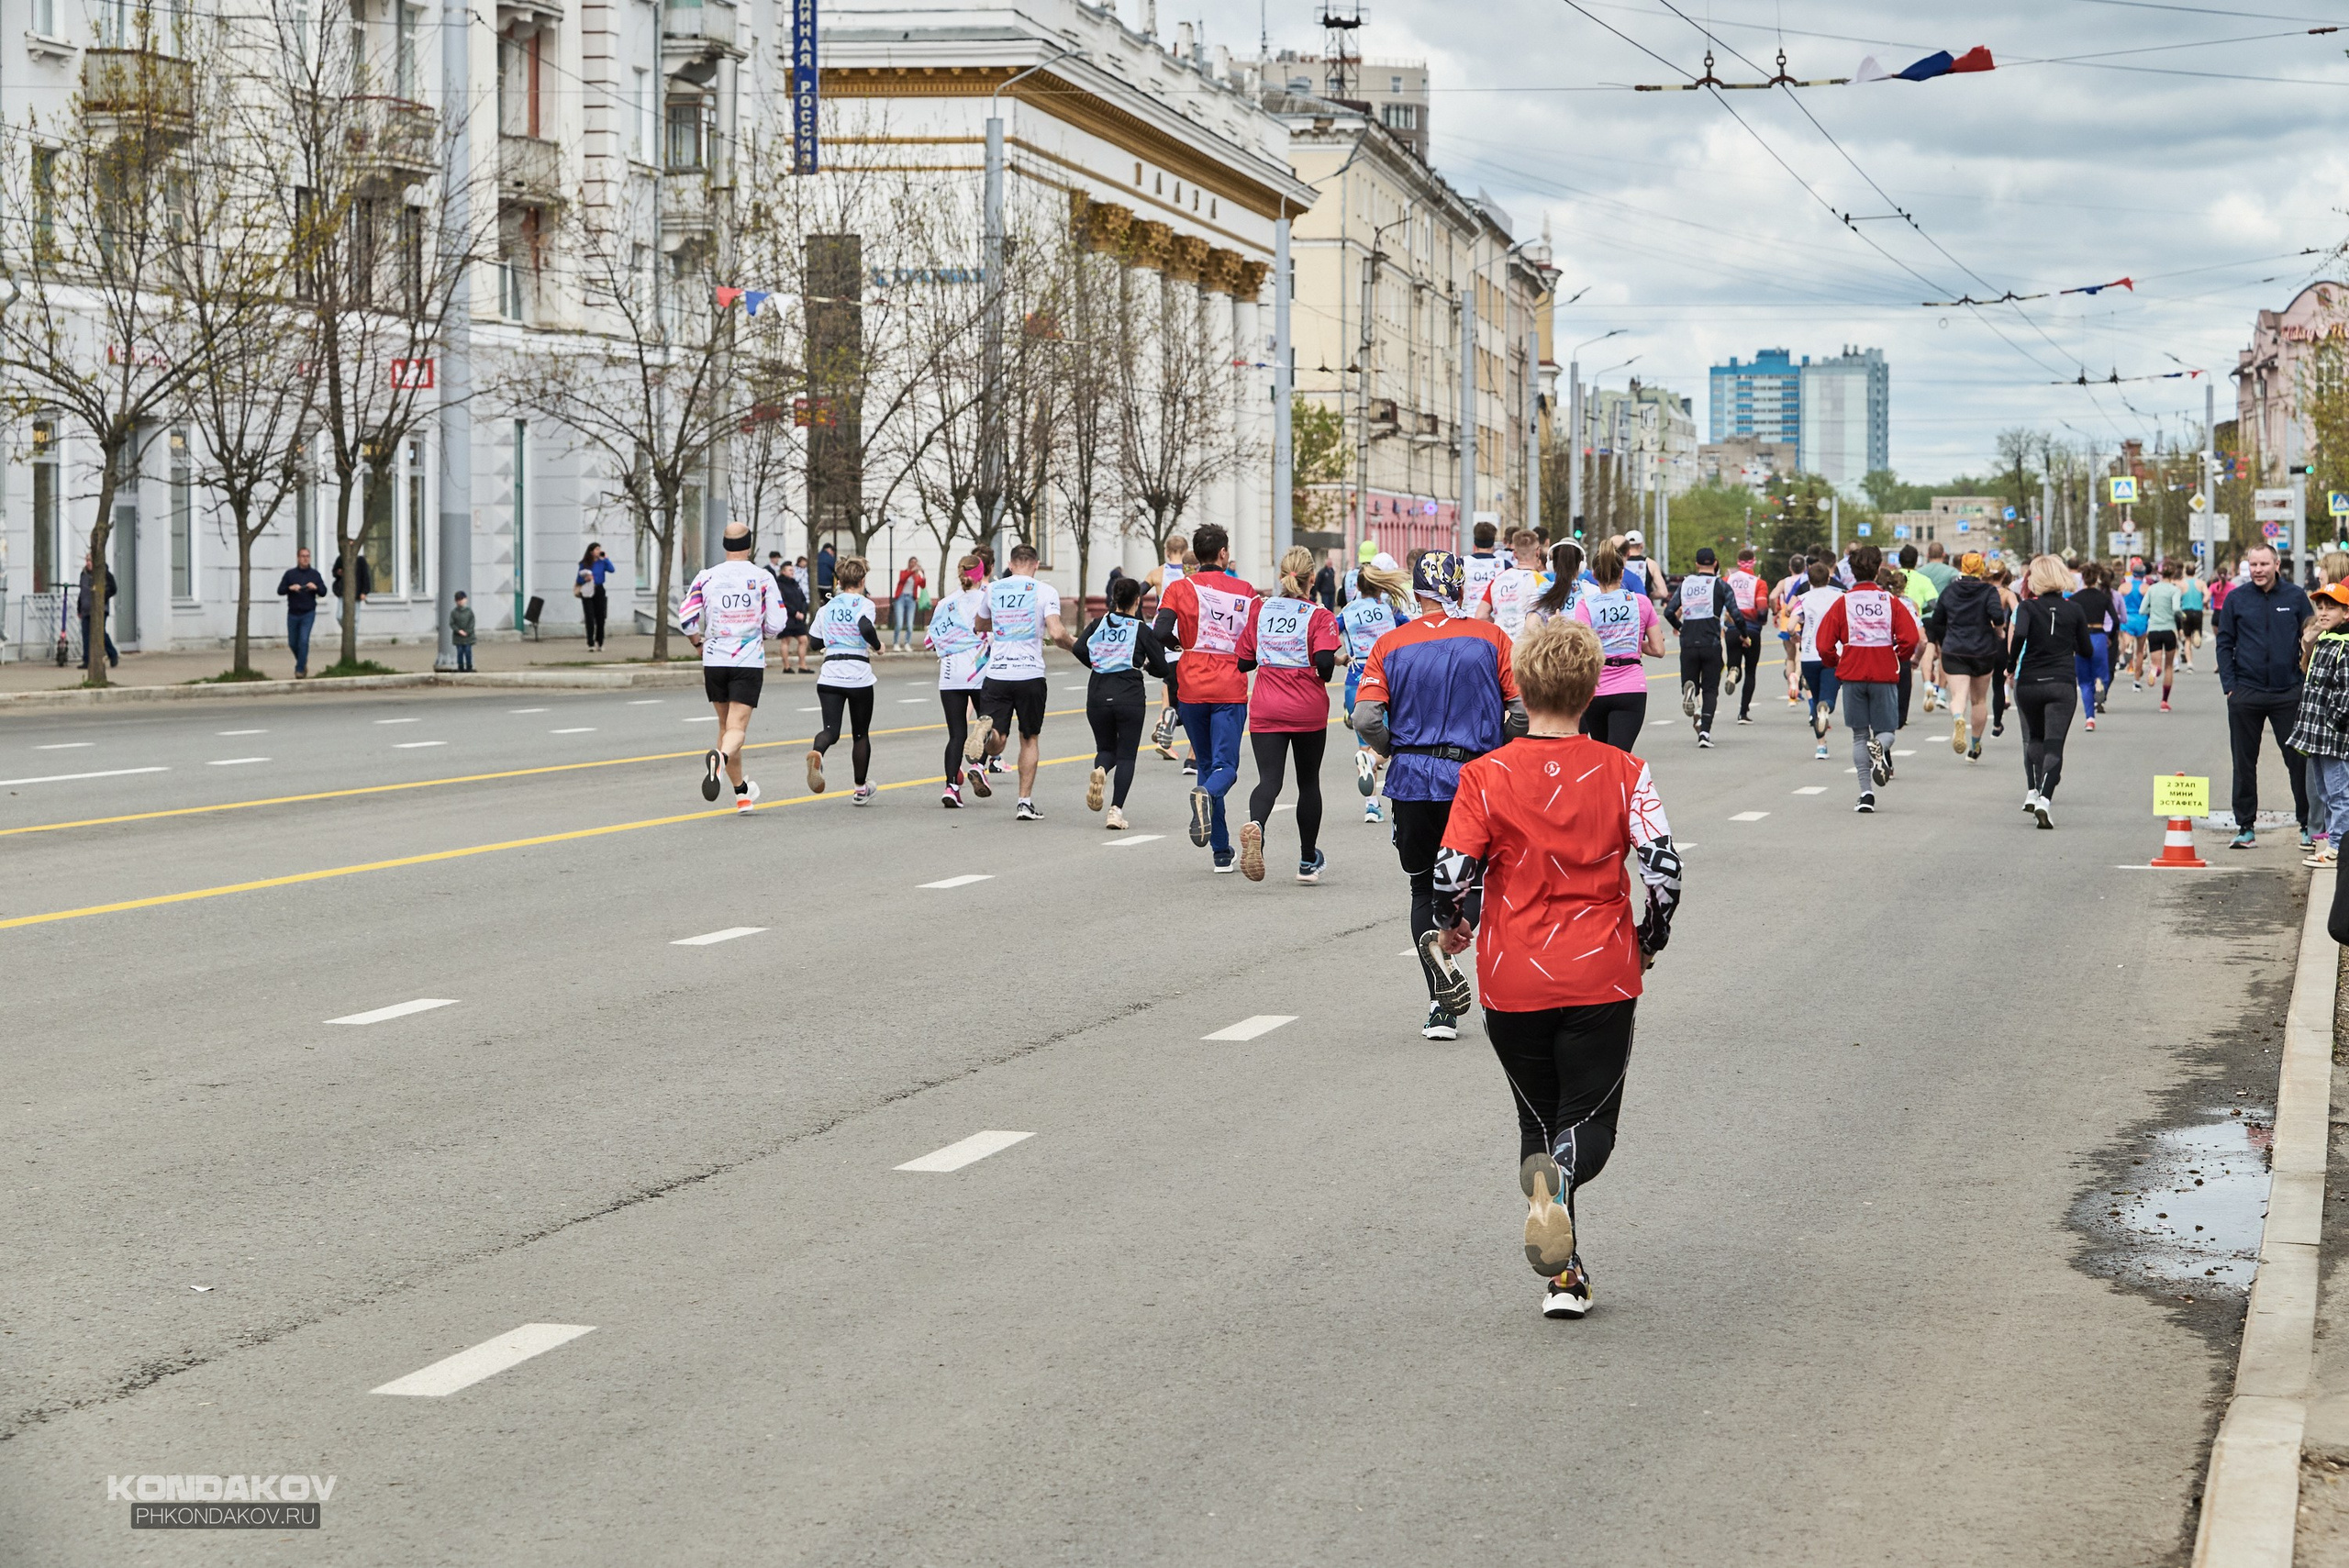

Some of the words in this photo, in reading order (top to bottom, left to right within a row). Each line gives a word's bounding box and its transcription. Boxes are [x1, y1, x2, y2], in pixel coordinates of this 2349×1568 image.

[799, 81, 812, 165] РОССИЯ
[1474, 571, 1496, 582] 043
[1687, 586, 1707, 596] 085
[721, 593, 751, 608] 079
[998, 594, 1026, 608] 127
[829, 608, 852, 622] 138
[1354, 607, 1383, 625] 136
[1599, 606, 1631, 623] 132
[1855, 604, 1884, 617] 058
[934, 616, 954, 637] 134
[1267, 617, 1297, 633] 129
[1099, 628, 1127, 642] 130
